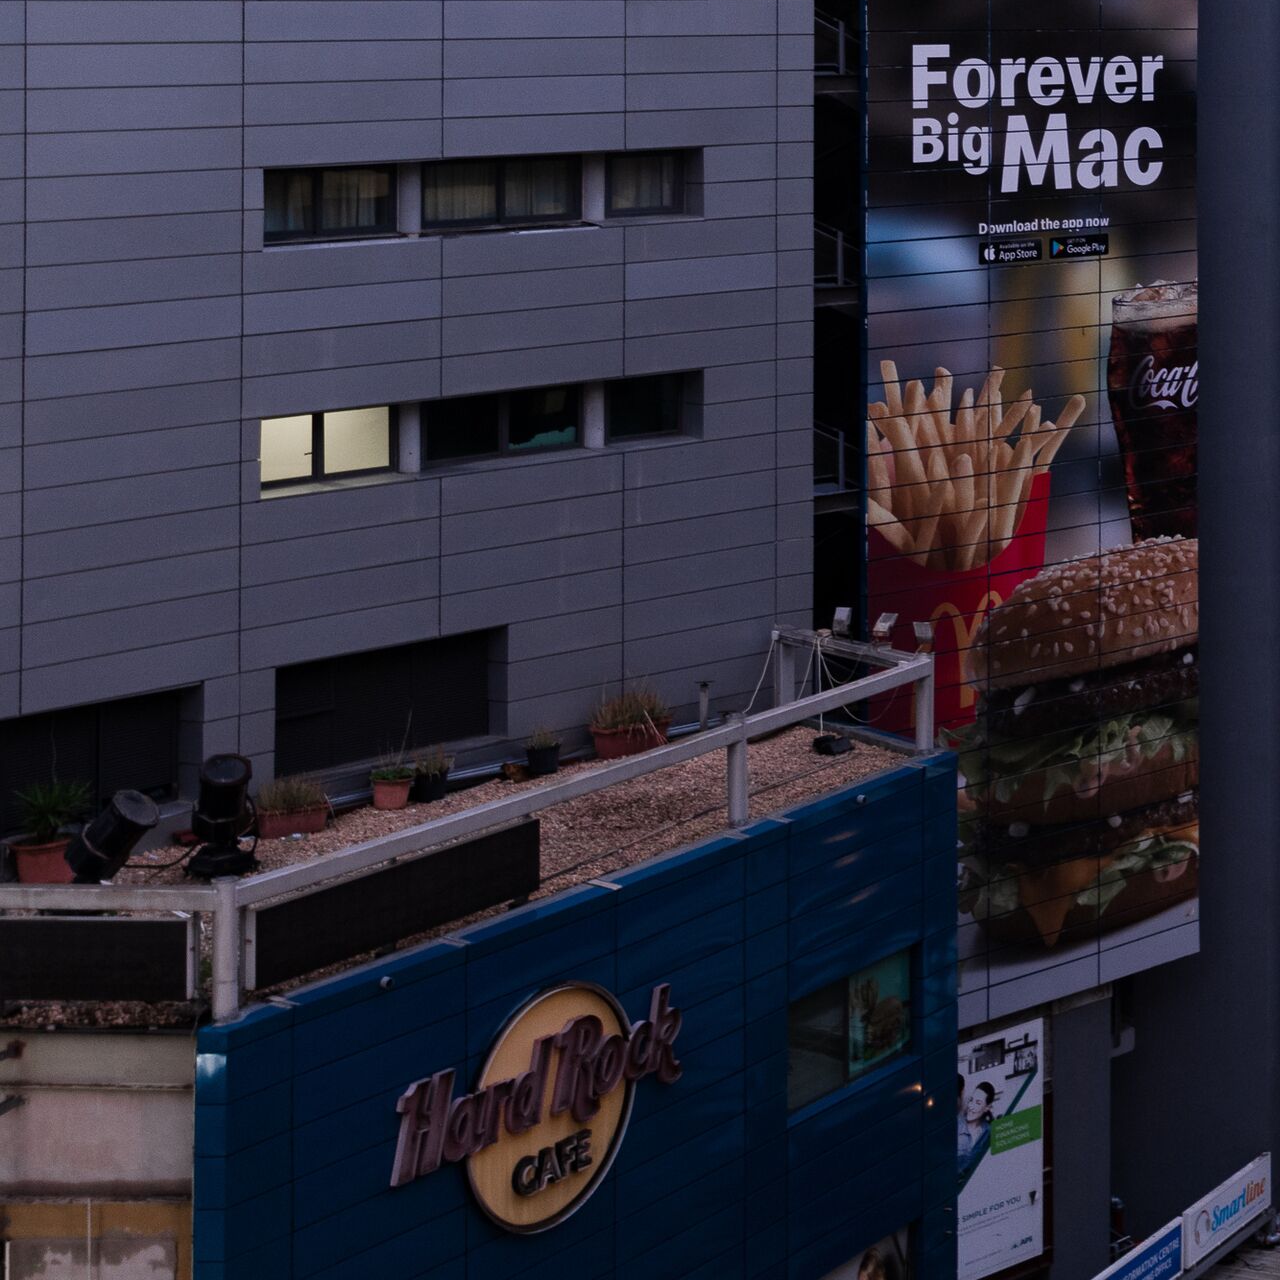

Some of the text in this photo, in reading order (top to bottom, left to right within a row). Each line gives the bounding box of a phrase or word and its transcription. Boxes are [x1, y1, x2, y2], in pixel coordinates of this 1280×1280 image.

[912, 44, 1164, 109] Forever
[912, 111, 1164, 194] Big Mac
[978, 216, 1110, 235] Download the app now
[1066, 242, 1106, 255] Google Play
[998, 247, 1038, 262] App Store
[390, 982, 683, 1187] Hard Rock
[511, 1128, 593, 1197] CAFE
[962, 1195, 1022, 1223] SIMPLE FOR YOU
